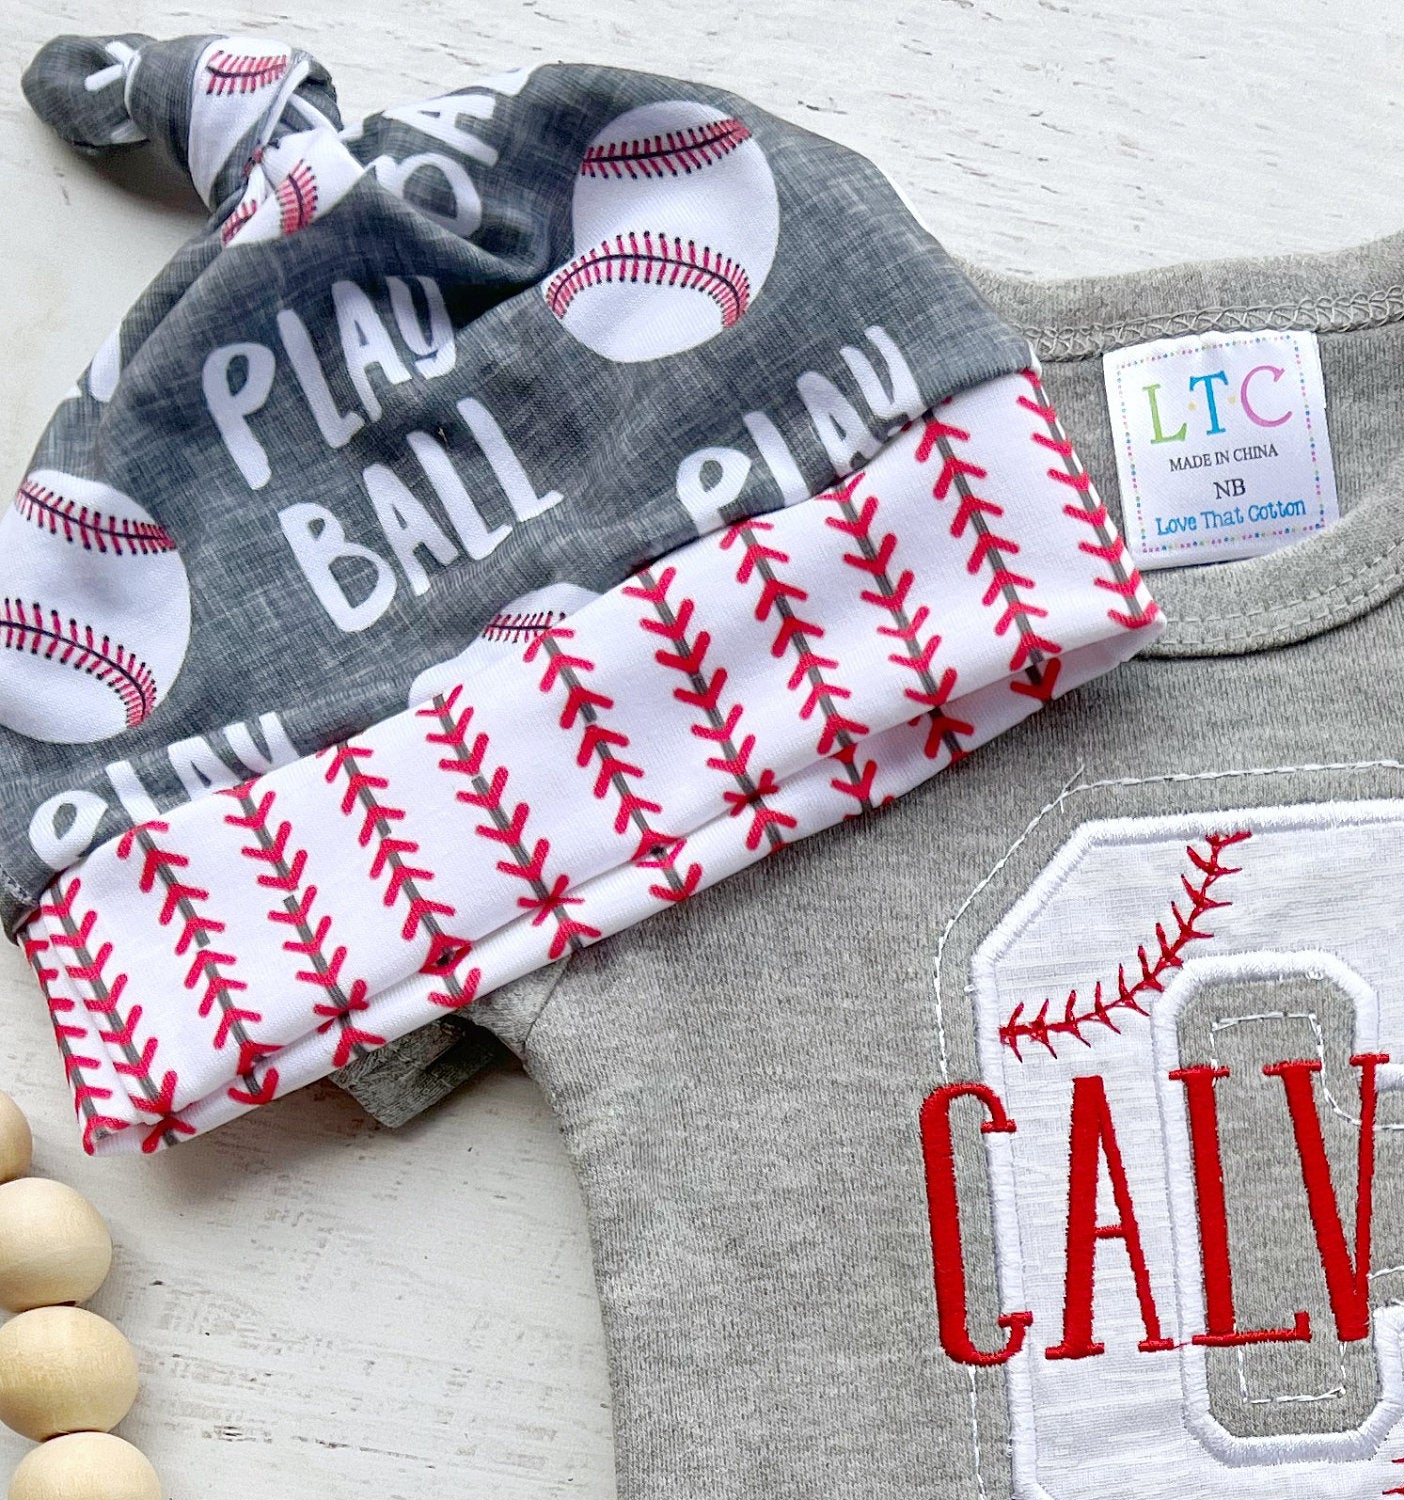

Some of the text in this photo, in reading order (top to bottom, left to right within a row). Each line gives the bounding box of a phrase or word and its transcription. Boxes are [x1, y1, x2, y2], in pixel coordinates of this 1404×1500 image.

[202, 276, 457, 490] PLAY
[676, 325, 928, 537] PLAY
[277, 397, 565, 632] BALL
[1155, 499, 1306, 535] Love That Cotton
[1169, 443, 1279, 472] MADE IN CHINA
[1213, 478, 1246, 500] NB
